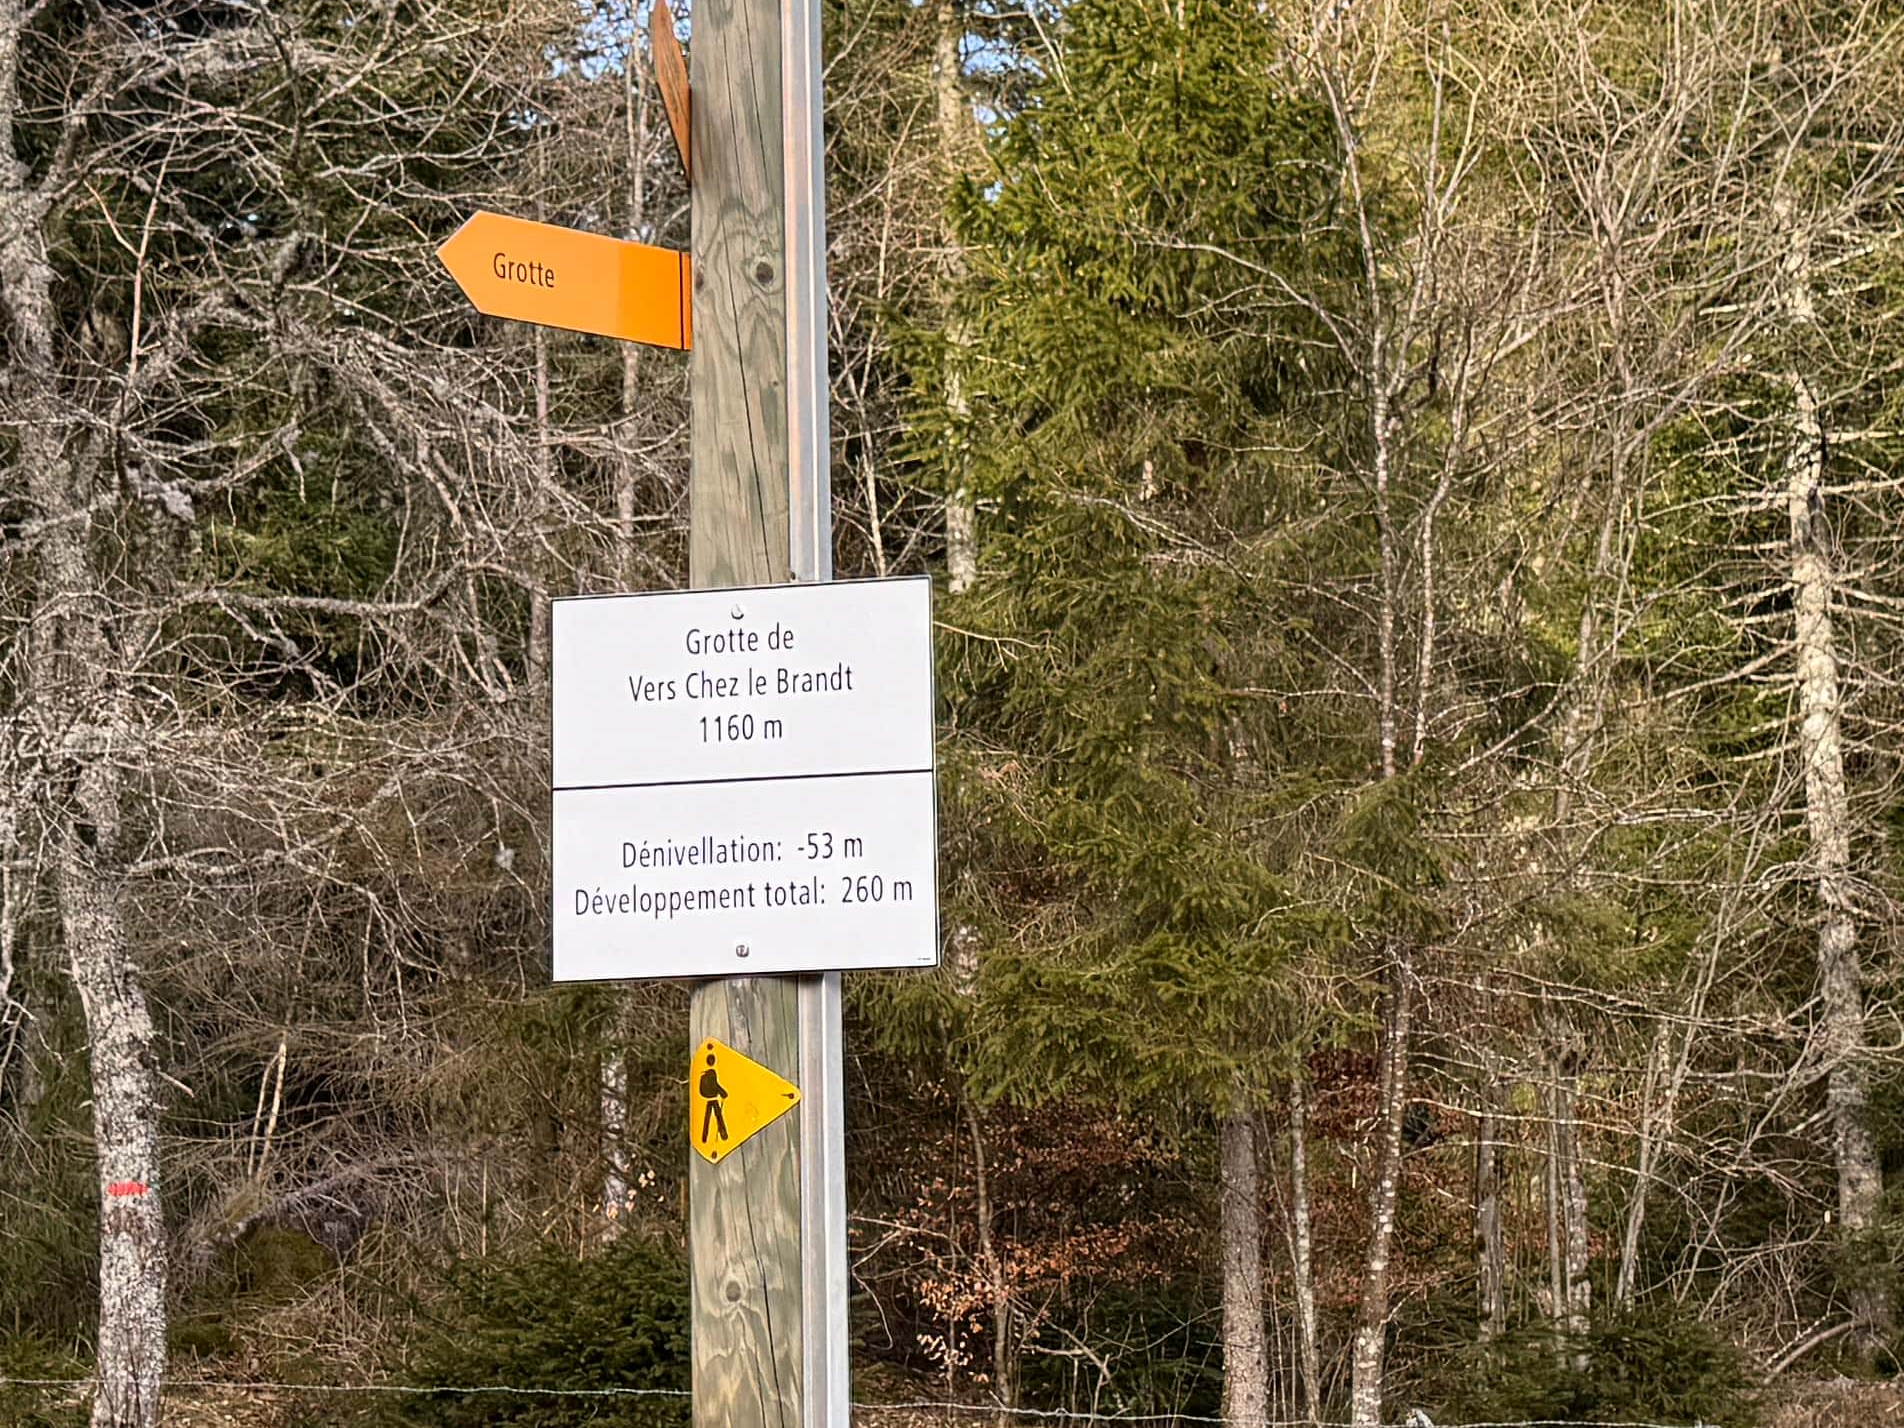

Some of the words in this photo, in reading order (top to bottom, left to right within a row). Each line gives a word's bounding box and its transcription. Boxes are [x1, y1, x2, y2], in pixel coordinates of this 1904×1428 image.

[493, 252, 555, 289] Grotte
[686, 628, 759, 655] Grotte
[767, 621, 794, 651] de
[628, 675, 676, 702] Vers
[685, 670, 739, 700] Chez
[748, 667, 767, 697] le
[777, 662, 853, 695] Brandt
[699, 713, 754, 743] 1160
[763, 719, 783, 740] m
[622, 835, 782, 869] Dénivellation:
[797, 831, 833, 860] -53
[844, 837, 863, 859] m
[575, 883, 756, 920] Développement
[764, 875, 825, 908] total:
[841, 874, 884, 904] 260
[893, 880, 913, 901] m
